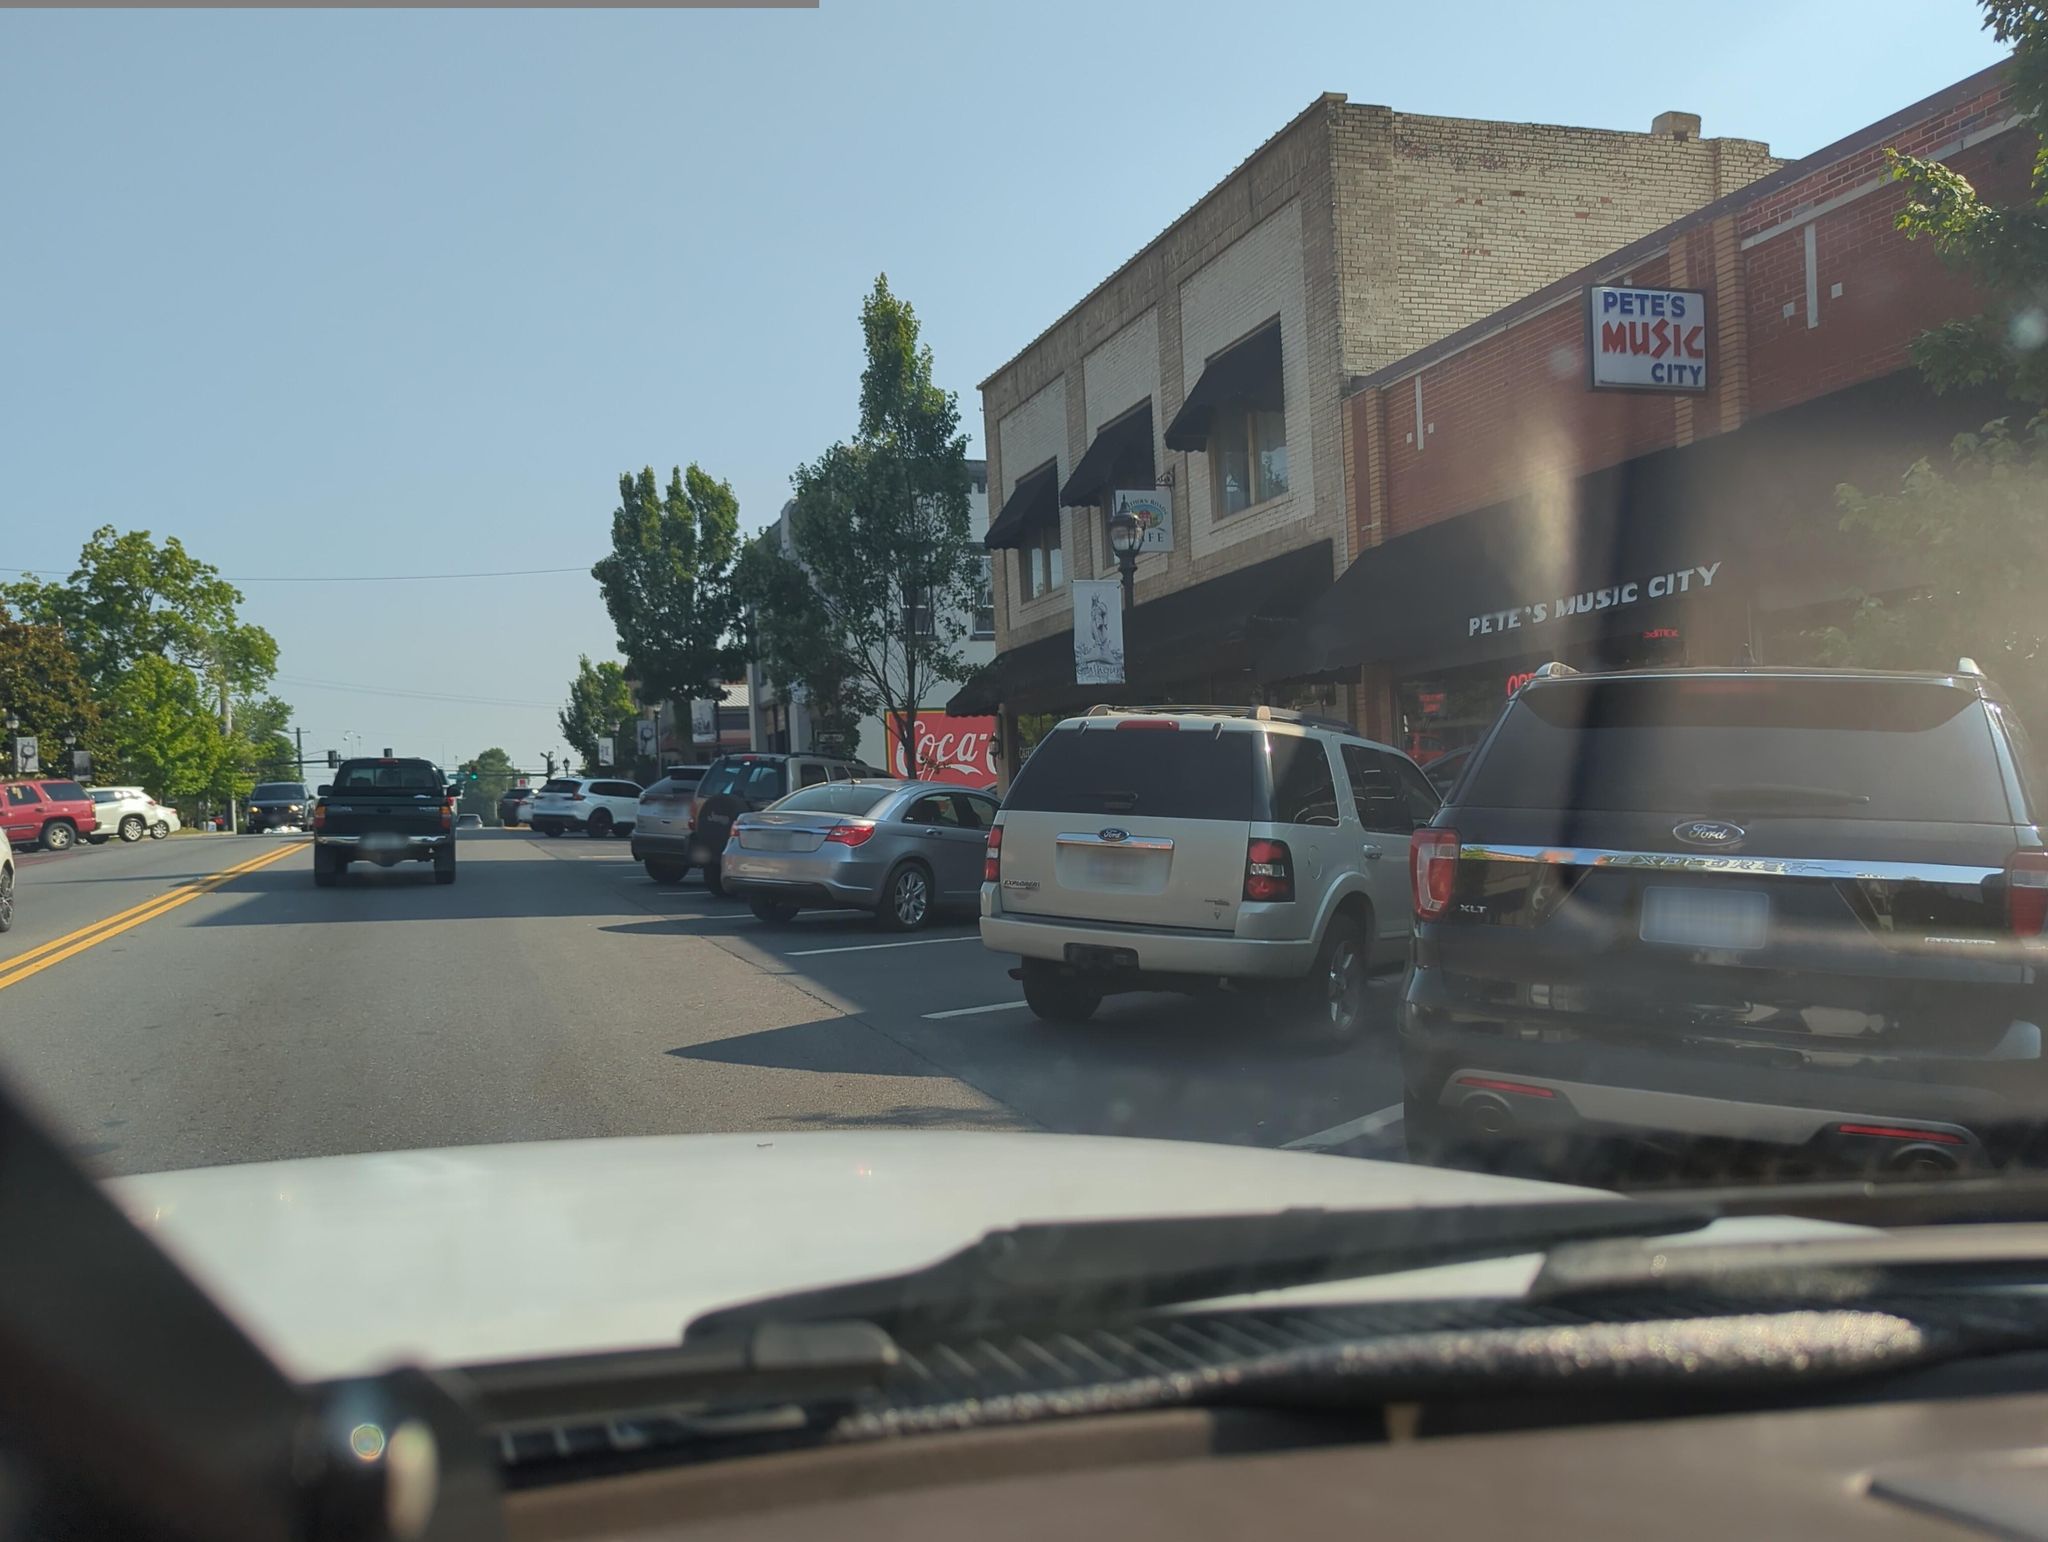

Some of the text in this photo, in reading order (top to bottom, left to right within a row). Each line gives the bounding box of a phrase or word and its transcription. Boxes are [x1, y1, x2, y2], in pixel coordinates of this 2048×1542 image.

[1603, 291, 1686, 318] PETE'S
[1602, 318, 1704, 360] MUSIC
[1651, 362, 1703, 386] CITY
[1468, 561, 1722, 637] PETE'S MUSIC CITY
[1689, 823, 1728, 841] Ford
[1459, 903, 1488, 914] XLT
